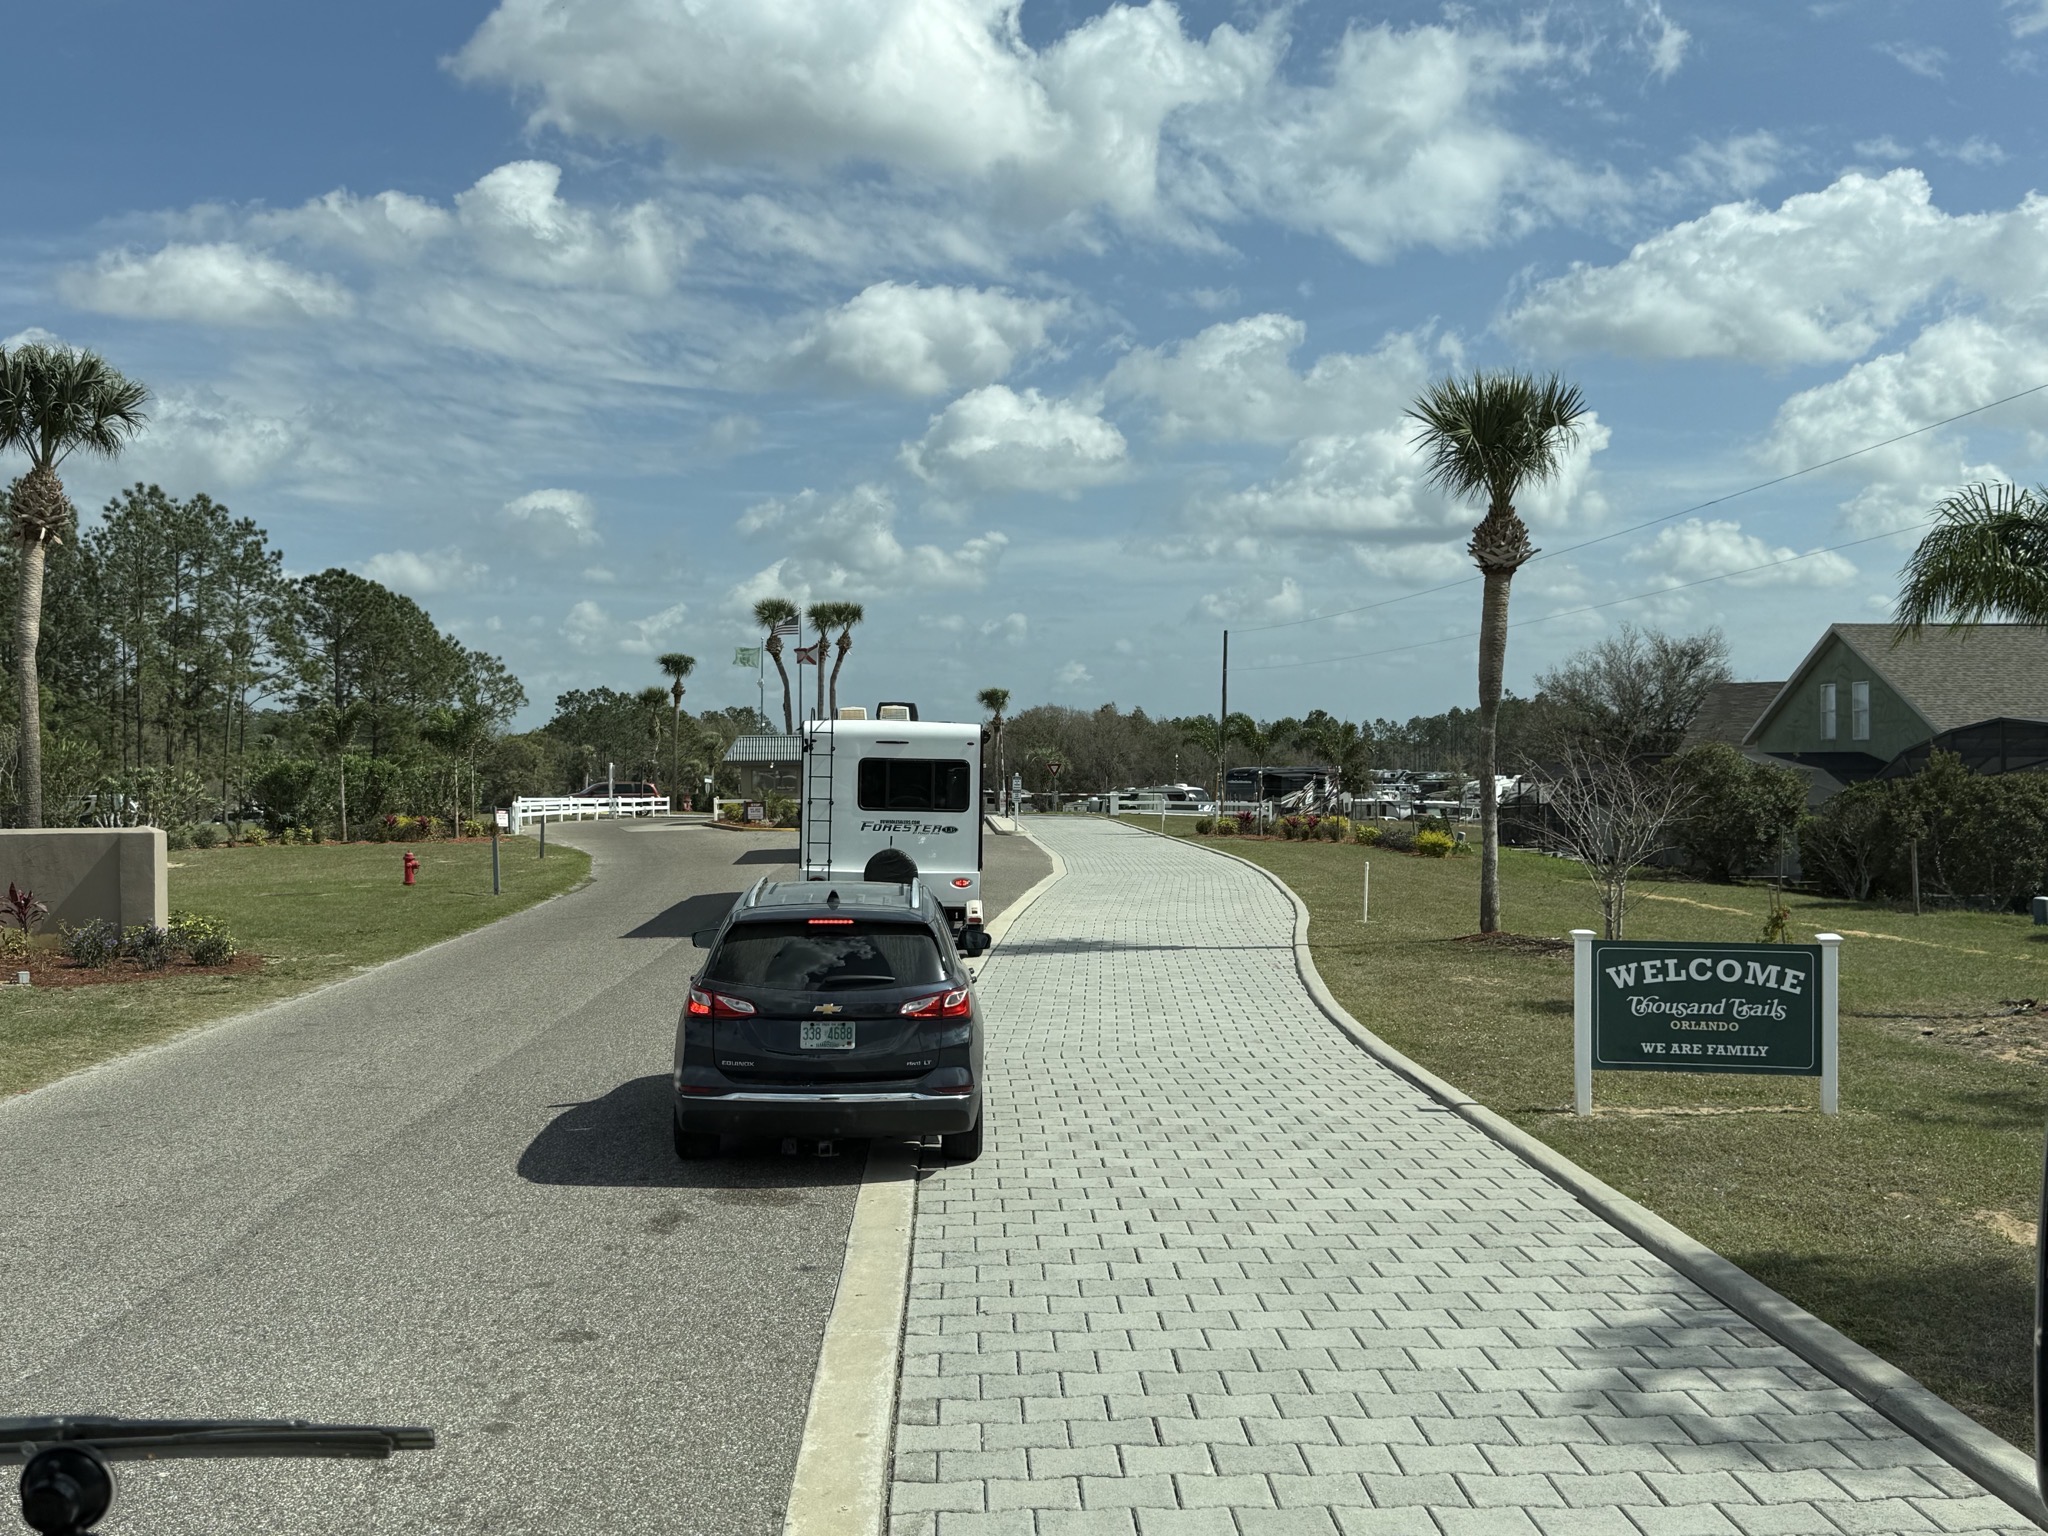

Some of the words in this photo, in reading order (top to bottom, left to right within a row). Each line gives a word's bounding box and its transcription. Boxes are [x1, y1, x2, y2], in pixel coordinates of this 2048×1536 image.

[860, 821, 943, 833] FORESTER
[1605, 957, 1806, 995] WELCOME
[1626, 995, 1726, 1018] Thousand
[1728, 997, 1787, 1021] Trails
[802, 1027, 822, 1041] 338
[827, 1026, 853, 1040] 4688
[1670, 1020, 1739, 1032] ORLANDO
[1641, 1042, 1666, 1054] WE
[1670, 1043, 1702, 1055] ARE
[1707, 1044, 1769, 1057] FAMILY
